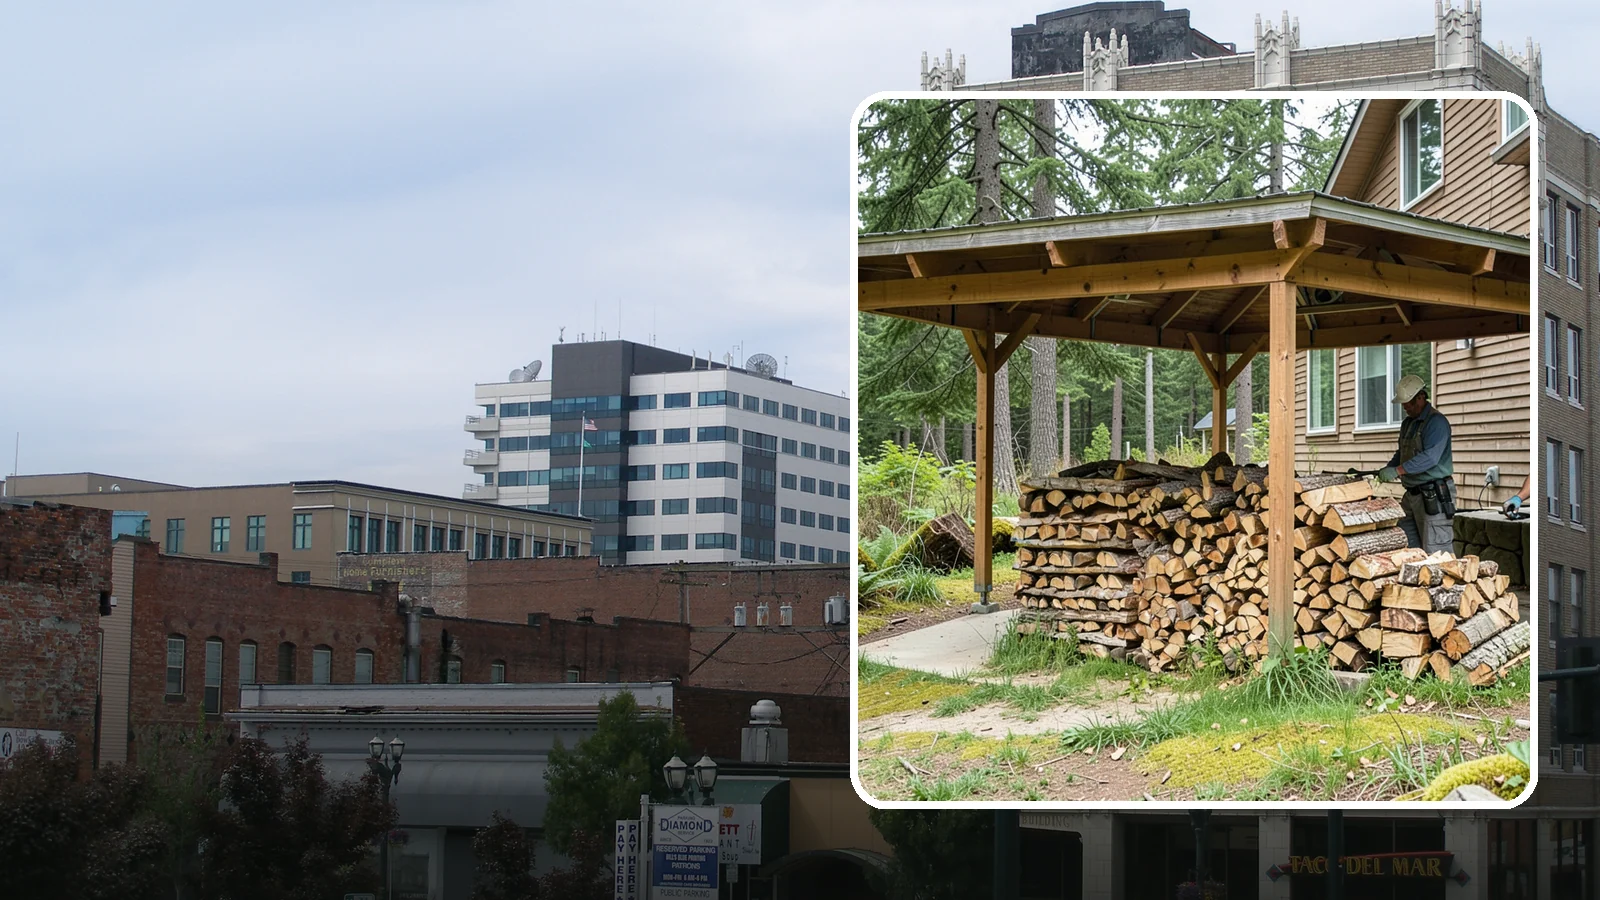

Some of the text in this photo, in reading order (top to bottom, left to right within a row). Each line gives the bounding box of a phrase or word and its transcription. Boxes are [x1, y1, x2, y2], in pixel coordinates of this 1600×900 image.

[370, 566, 427, 576] Furnishers
[660, 818, 713, 832] DIAMOND
[1022, 815, 1070, 828] BUILDING
[656, 845, 716, 854] RESERVED PARKING
[616, 825, 625, 894] PAY HERE
[627, 824, 636, 893] PAY HERE
[721, 851, 739, 861] Soup
[671, 862, 701, 870] PATRONS
[1290, 856, 1442, 877] TAC DEL MAR
[660, 888, 710, 898] PUBLIC PARKING
